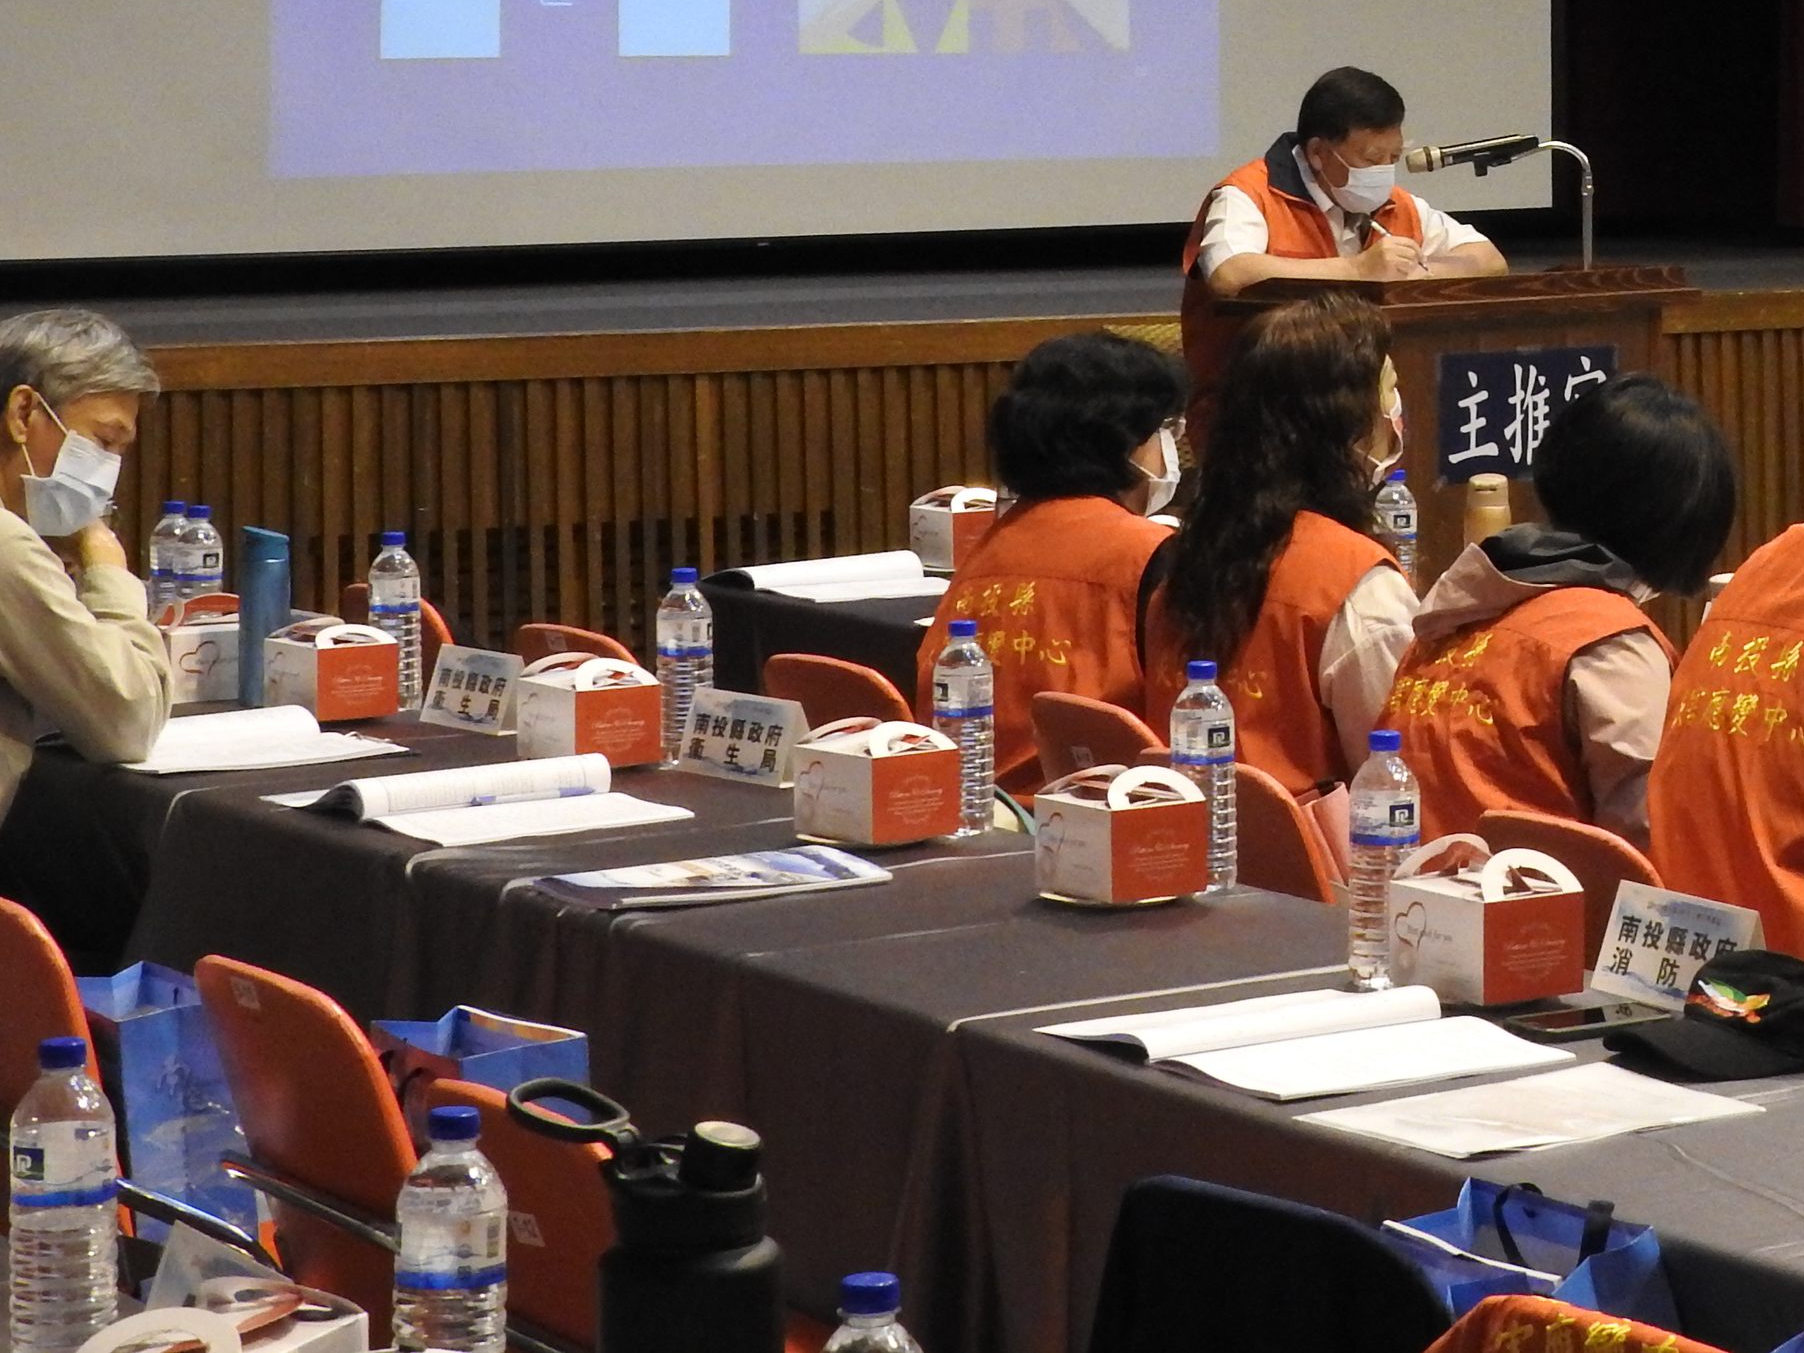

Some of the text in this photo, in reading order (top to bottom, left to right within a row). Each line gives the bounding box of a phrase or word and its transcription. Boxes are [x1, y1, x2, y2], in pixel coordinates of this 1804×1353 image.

[1709, 631, 1804, 682] 南投縣
[693, 712, 784, 748] 南投縣政府
